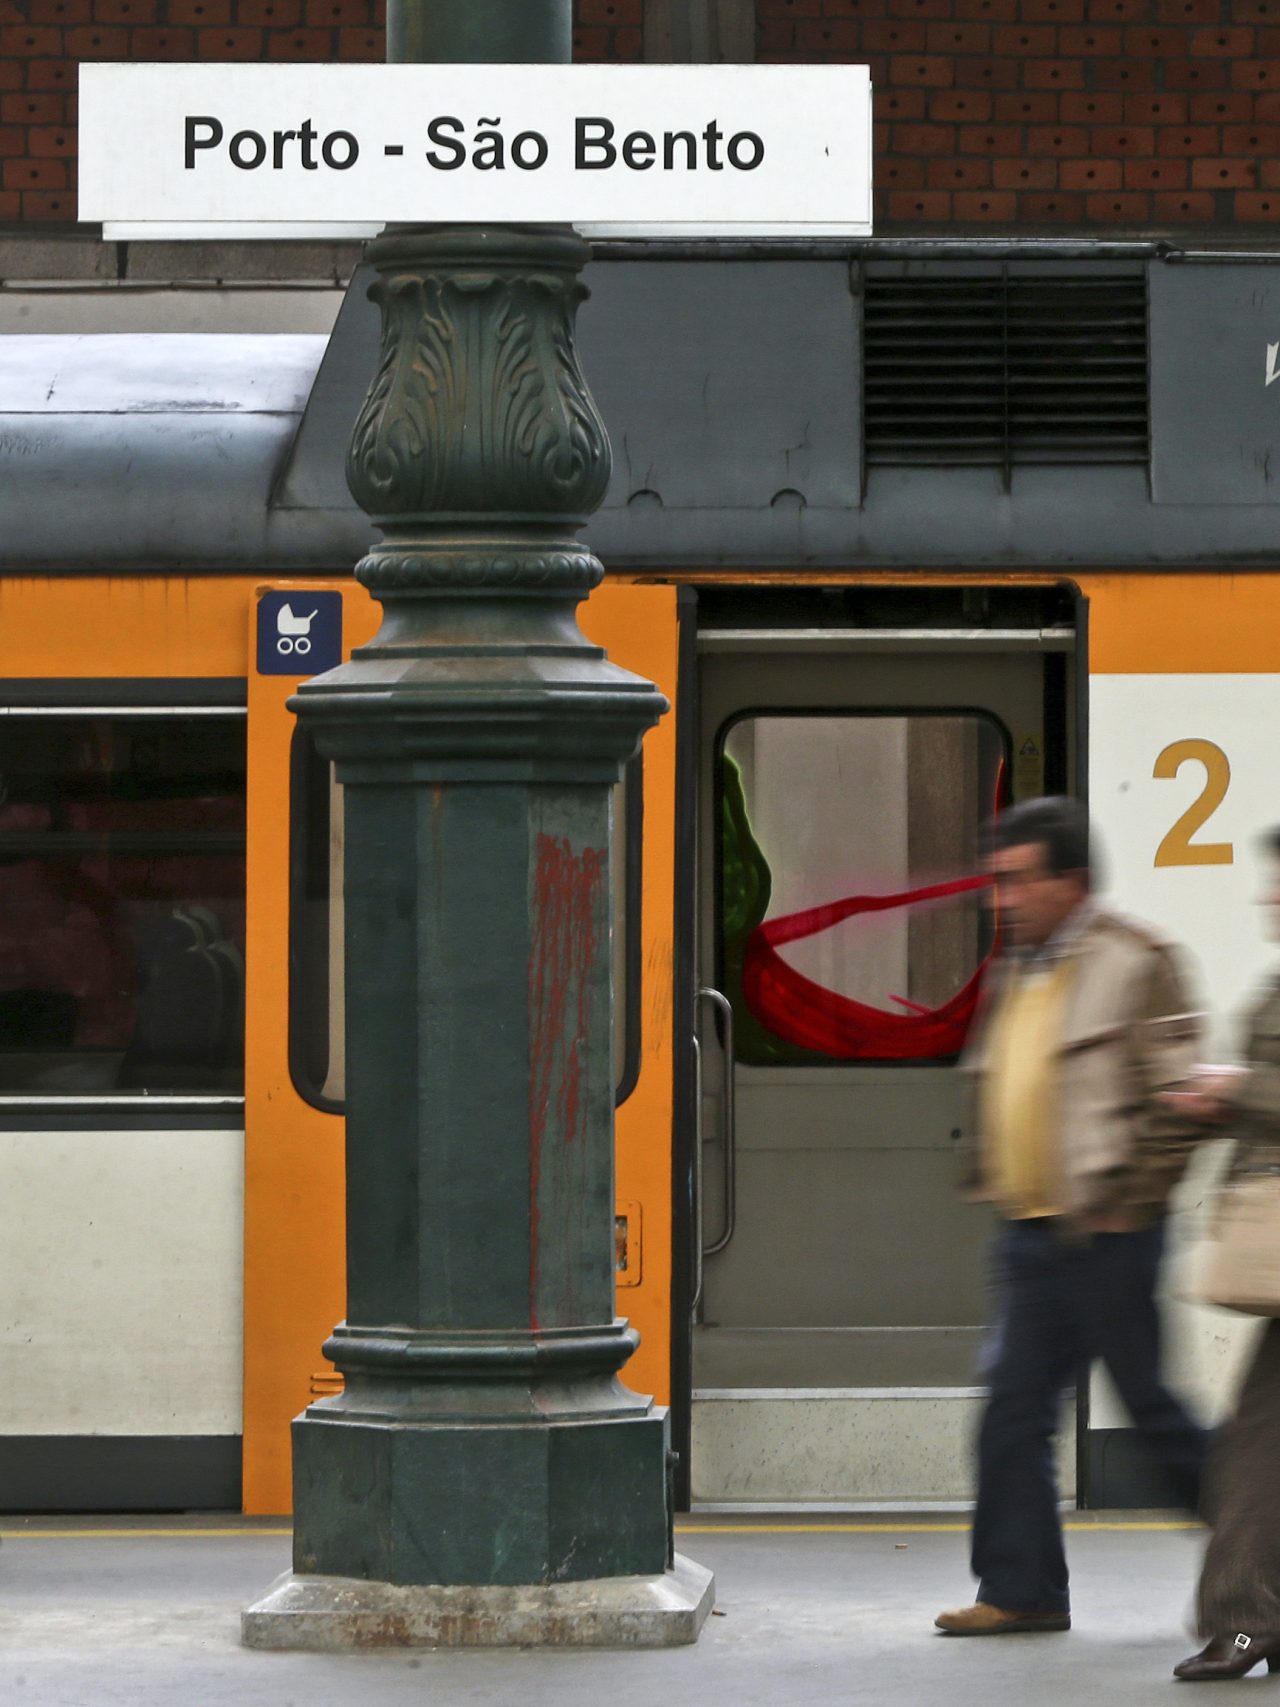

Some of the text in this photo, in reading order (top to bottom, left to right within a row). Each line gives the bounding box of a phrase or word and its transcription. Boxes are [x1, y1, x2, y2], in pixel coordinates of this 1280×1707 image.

[184, 116, 765, 170] Porto - São Bento
[1153, 739, 1234, 868] 2
